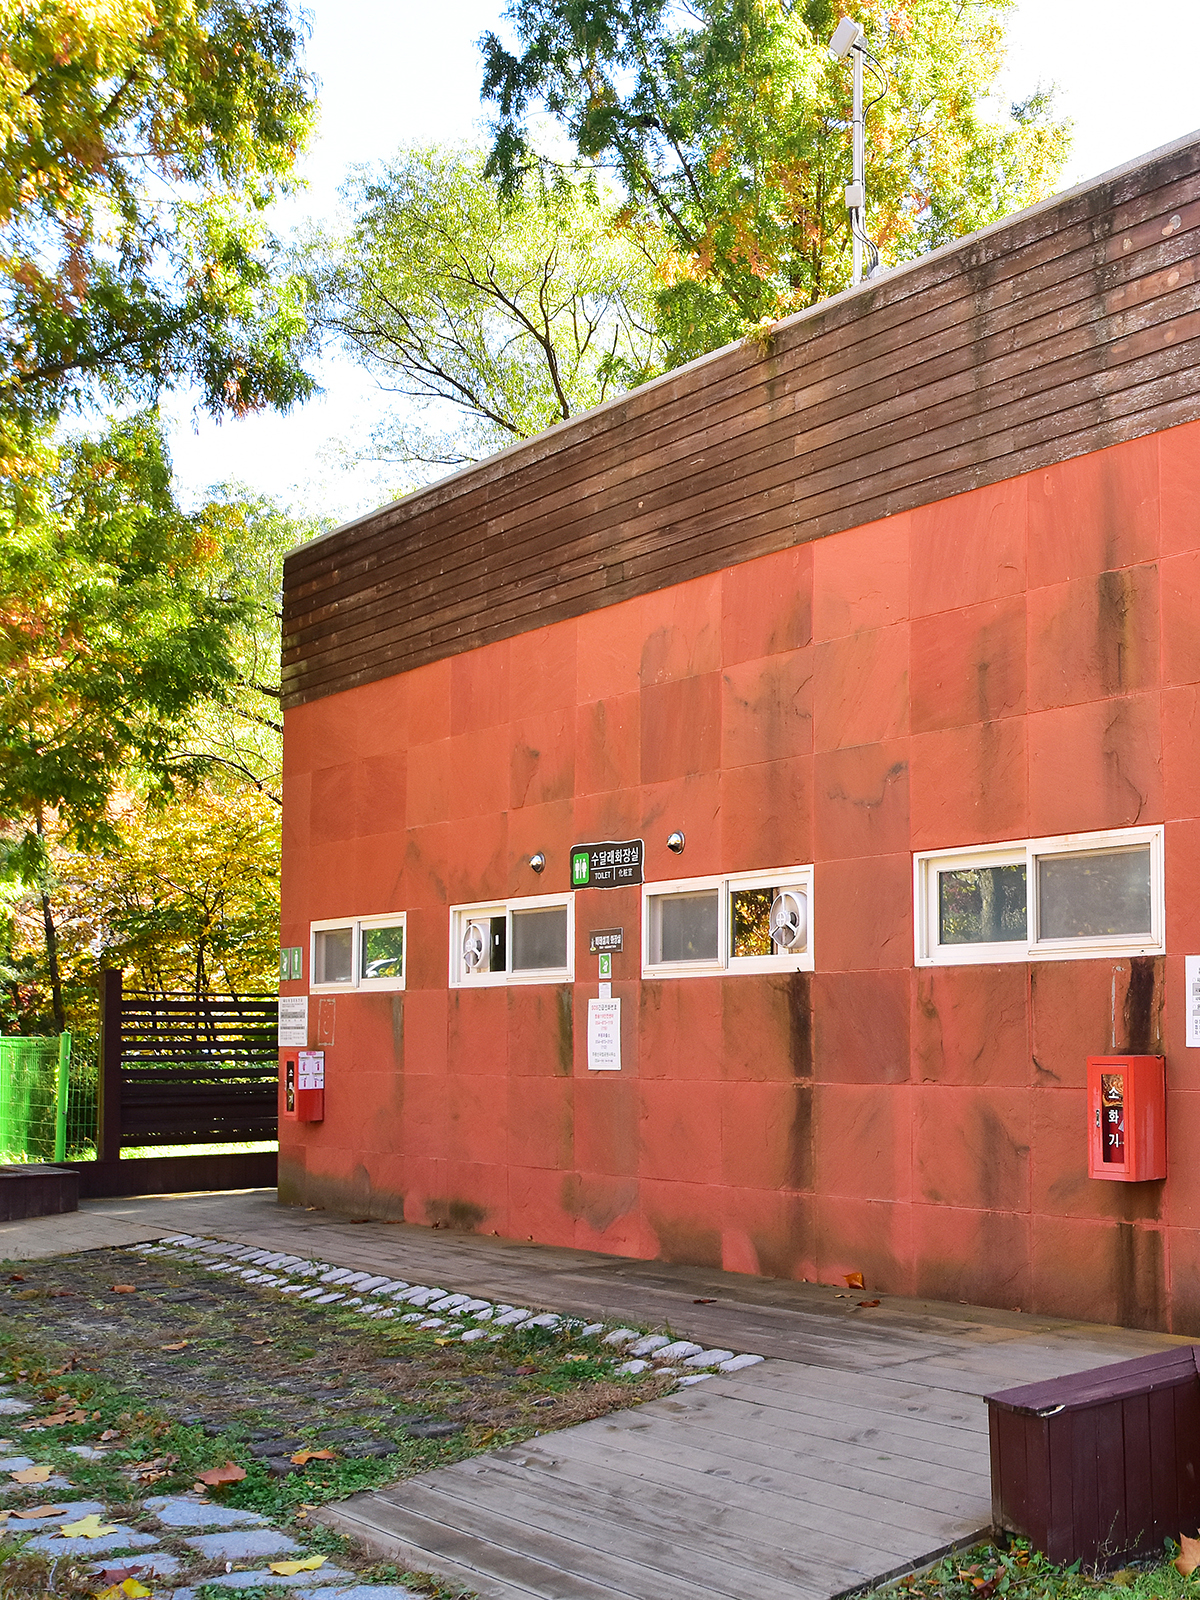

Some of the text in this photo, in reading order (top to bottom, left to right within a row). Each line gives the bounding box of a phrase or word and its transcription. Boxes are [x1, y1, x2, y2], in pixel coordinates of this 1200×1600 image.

[590, 847, 639, 866] 수달래화장실
[595, 871, 611, 880] TOILET
[1108, 1086, 1120, 1148] 소화기
